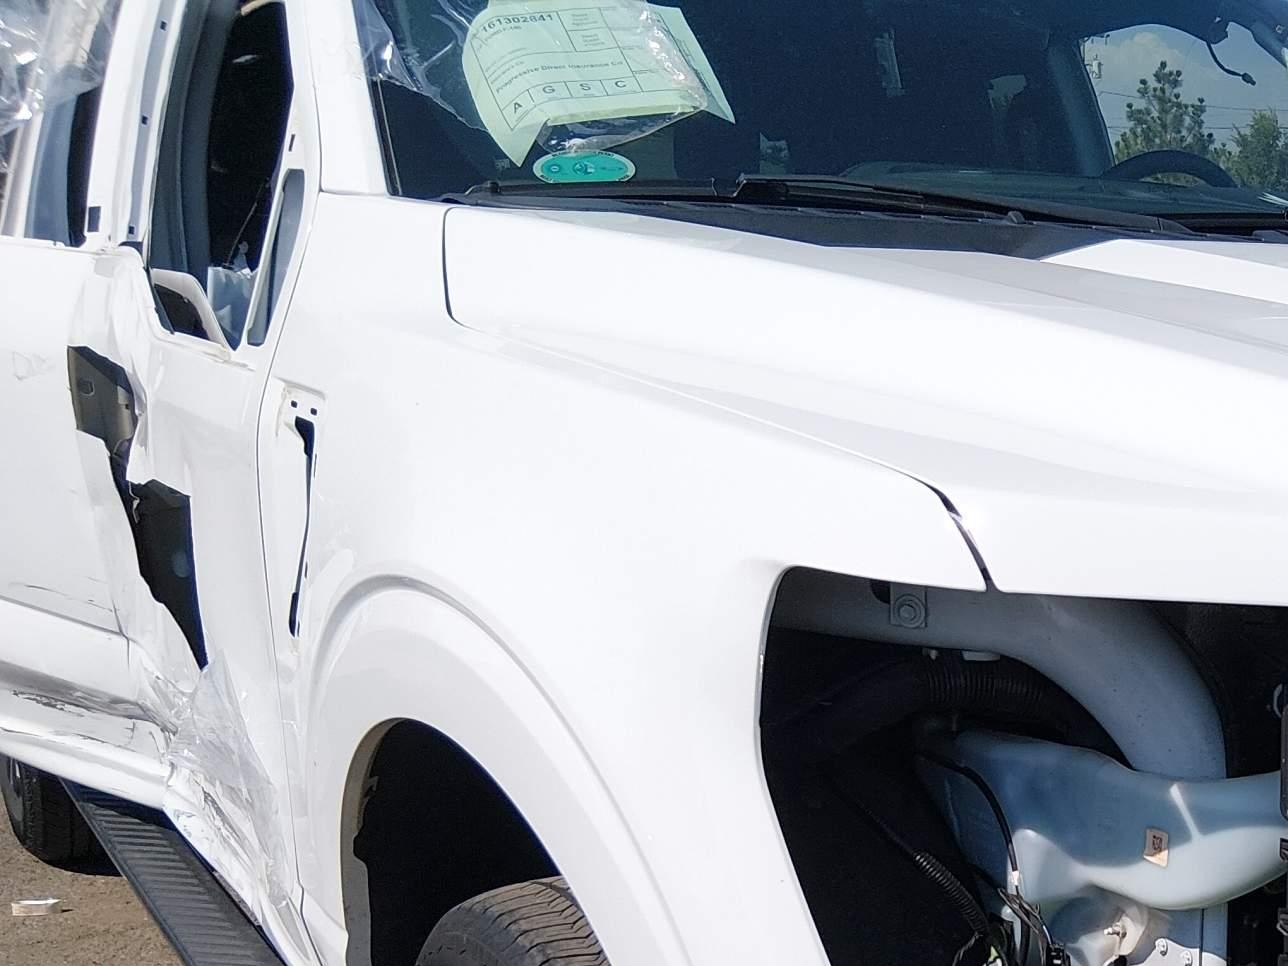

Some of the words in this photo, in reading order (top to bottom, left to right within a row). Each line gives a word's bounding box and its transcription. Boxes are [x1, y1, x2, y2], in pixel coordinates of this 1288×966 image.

[540, 64, 567, 72] Direct
[513, 101, 523, 114] A
[542, 85, 556, 94] G
[579, 82, 591, 91] S
[615, 80, 627, 88] C
